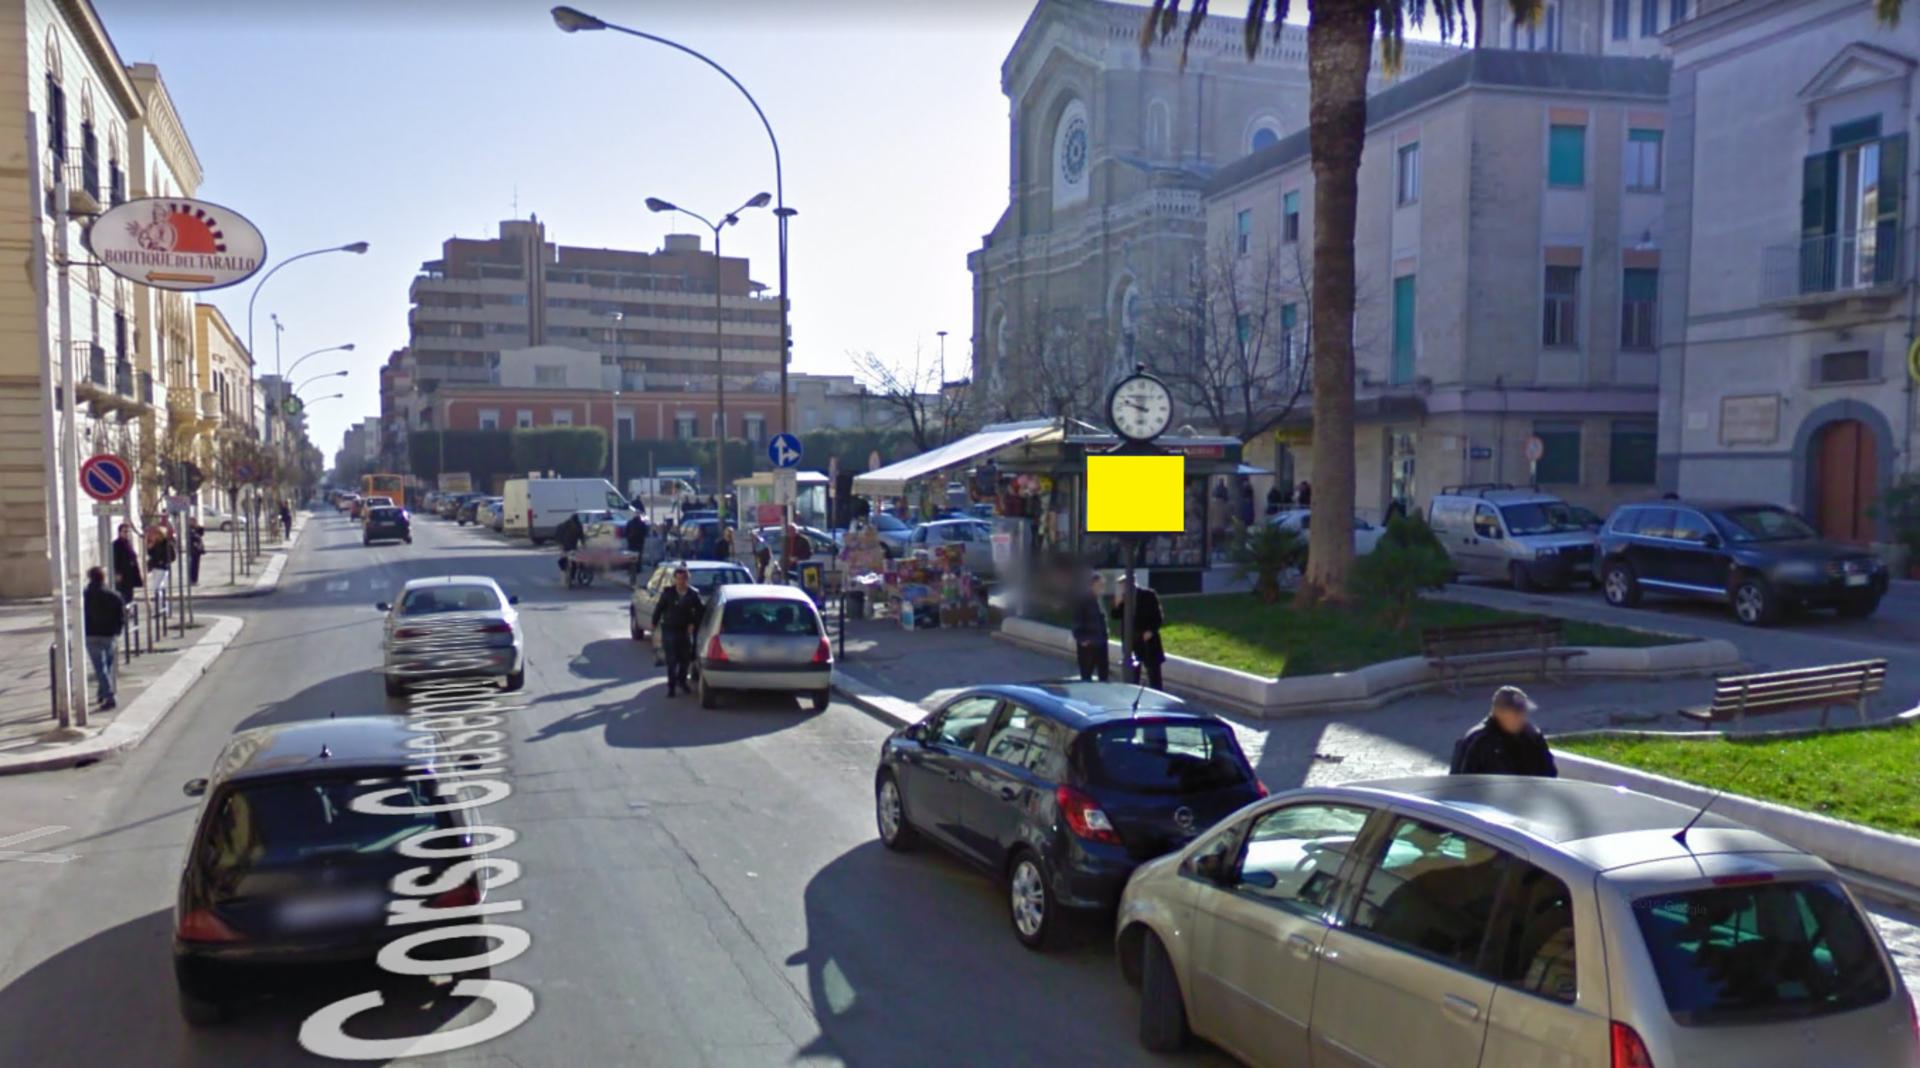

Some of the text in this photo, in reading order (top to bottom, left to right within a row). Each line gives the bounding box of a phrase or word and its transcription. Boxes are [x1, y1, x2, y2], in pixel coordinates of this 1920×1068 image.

[104, 248, 256, 272] BOUTIQUE DEL TARALLO
